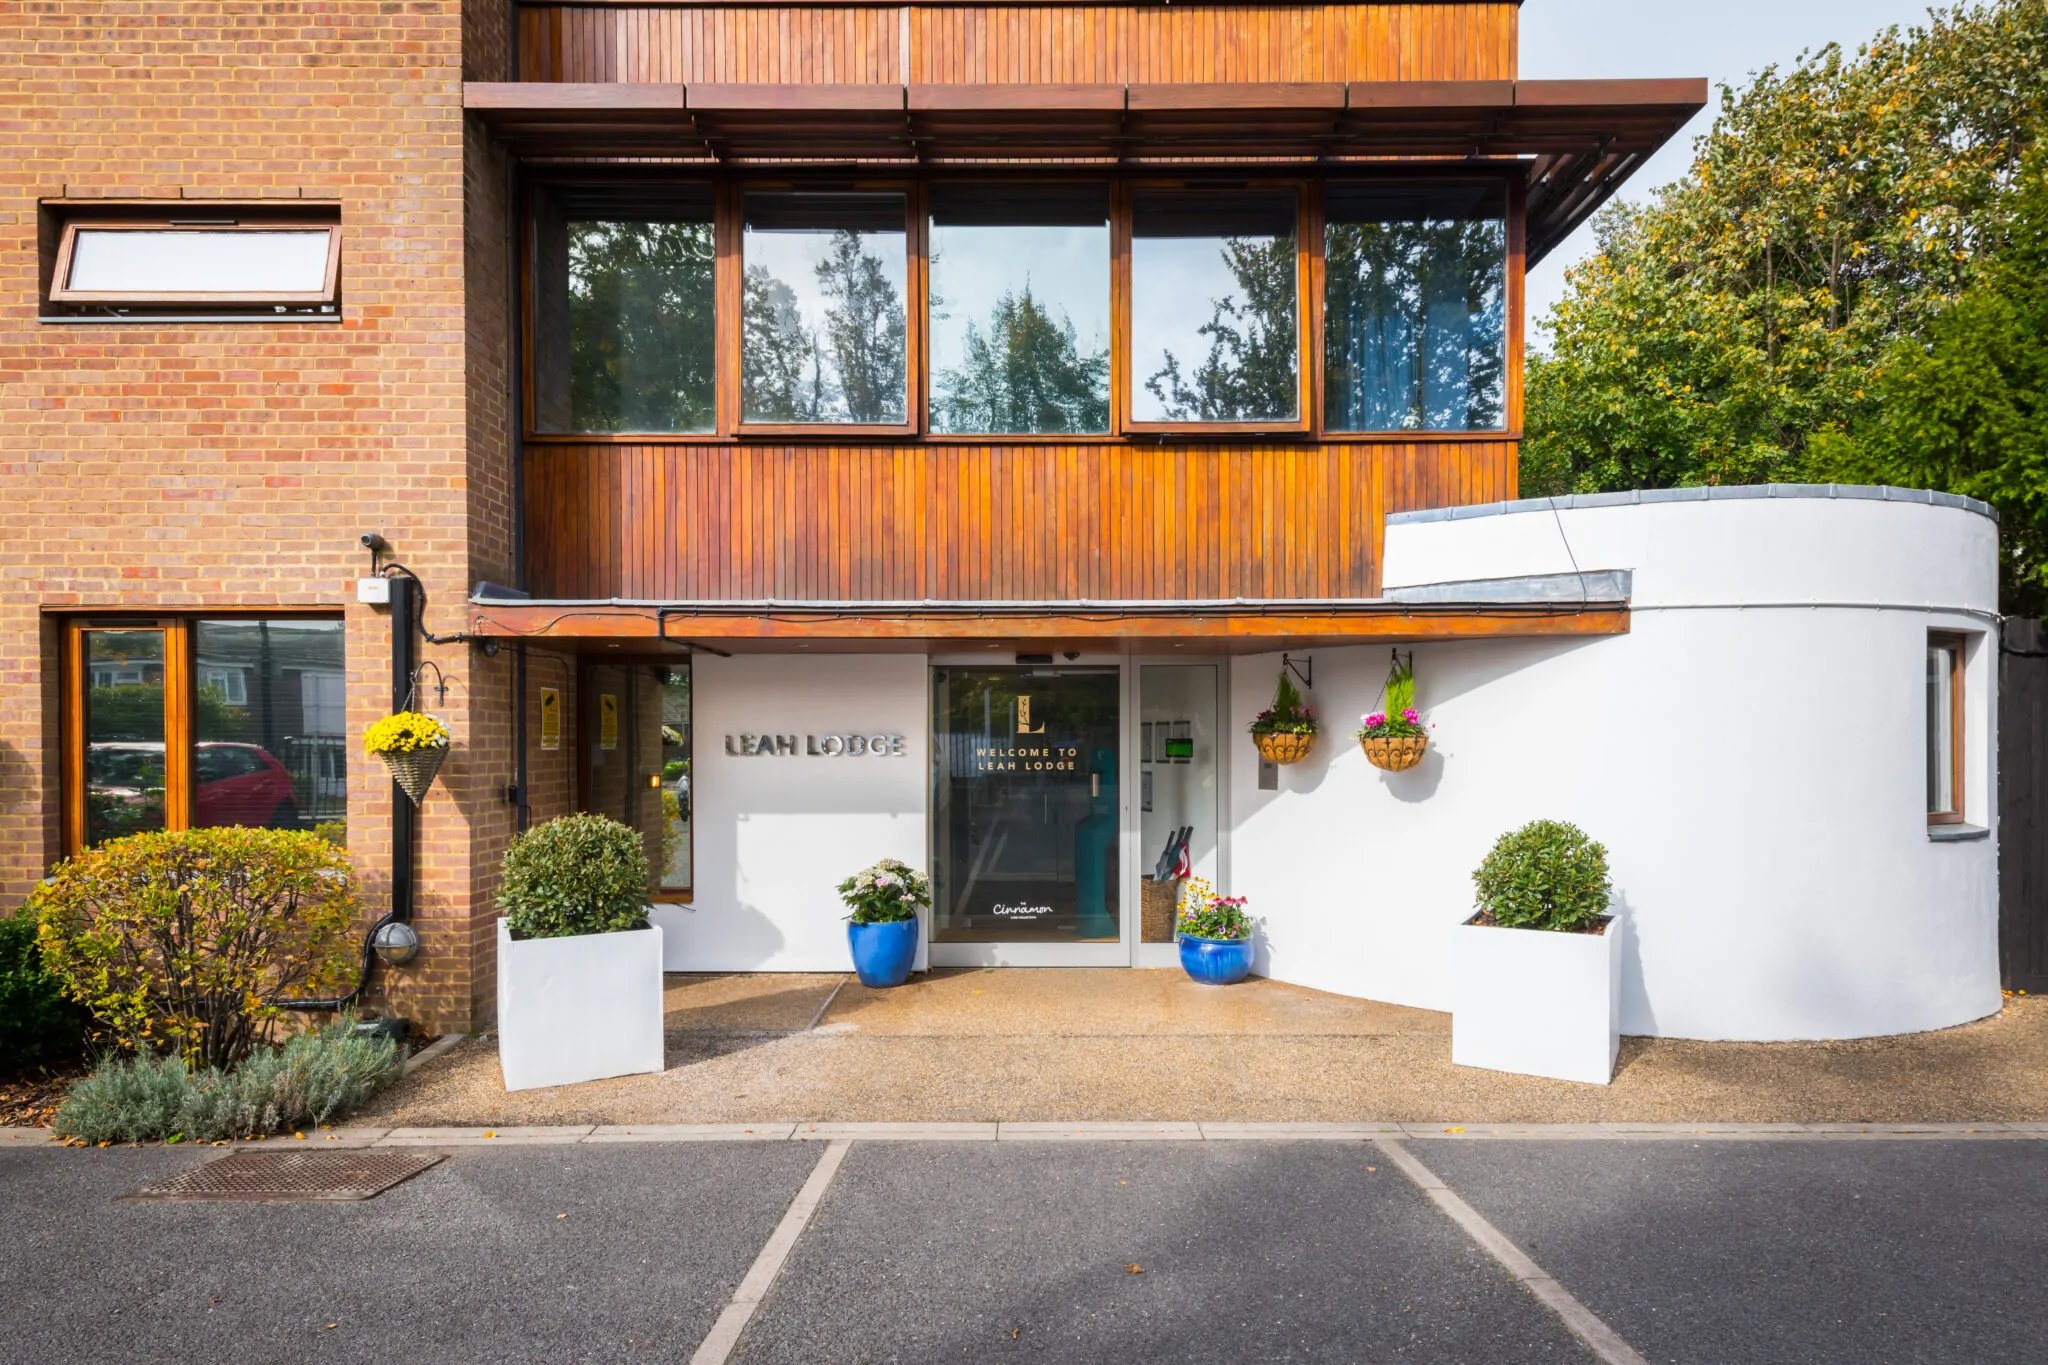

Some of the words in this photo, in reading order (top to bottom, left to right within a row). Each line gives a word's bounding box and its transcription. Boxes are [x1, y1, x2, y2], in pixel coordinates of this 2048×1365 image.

[725, 735, 796, 756] LEAH
[806, 735, 904, 756] LODGE
[976, 748, 1049, 757] WELCOME
[1059, 748, 1077, 757] TO
[978, 762, 1016, 771] LEAH
[1025, 762, 1075, 771] LODGE
[993, 904, 1053, 915] Cinnamon
